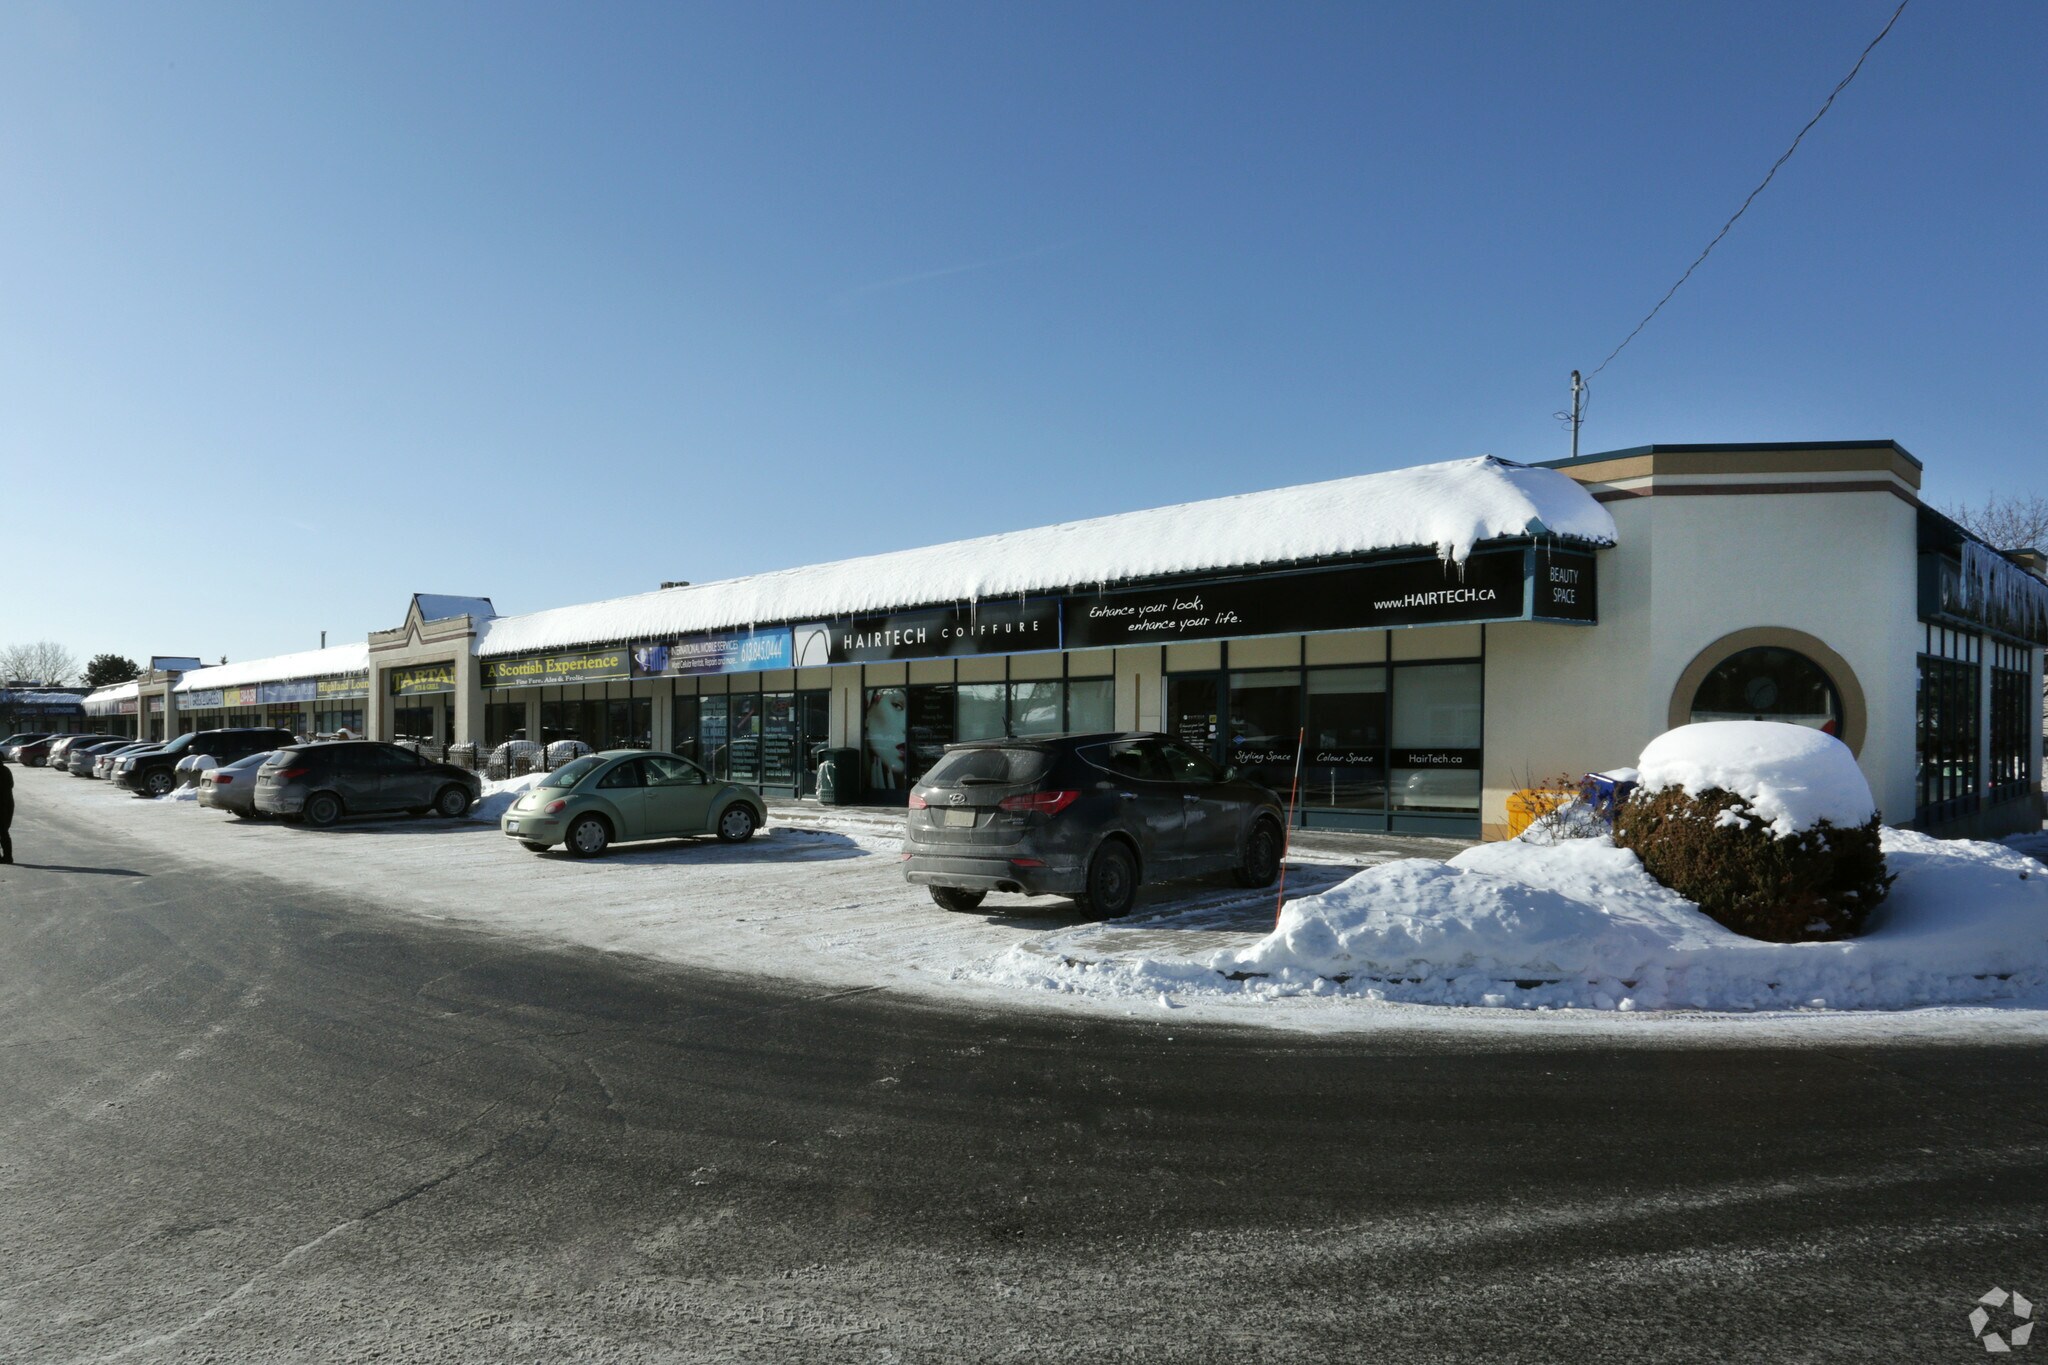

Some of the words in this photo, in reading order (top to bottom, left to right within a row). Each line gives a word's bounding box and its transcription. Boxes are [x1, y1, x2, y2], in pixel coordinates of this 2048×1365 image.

[1550, 566, 1578, 585] BEAUTY
[1374, 588, 1496, 610] www.HAIRTECH.CA
[1553, 587, 1575, 604] SPACE
[1089, 605, 1135, 618] Enhance
[1138, 603, 1168, 618] your
[1172, 595, 1204, 611] look,
[1127, 618, 1176, 632] enhance
[1179, 617, 1210, 632] your
[1214, 611, 1242, 625] life.
[843, 627, 926, 650] HAIRTECH
[941, 619, 1039, 639] COIFFURE
[718, 640, 738, 652] SERVICES
[488, 664, 498, 677] A
[499, 660, 544, 677] Scottish
[545, 655, 619, 675] Experience
[318, 679, 349, 693] Highland
[351, 677, 369, 690] Loun
[1234, 750, 1265, 764] Styling
[1266, 750, 1291, 765] Space
[1316, 752, 1344, 763] Colour
[1345, 752, 1374, 765] Space
[1408, 753, 1463, 764] HairTech.ca
